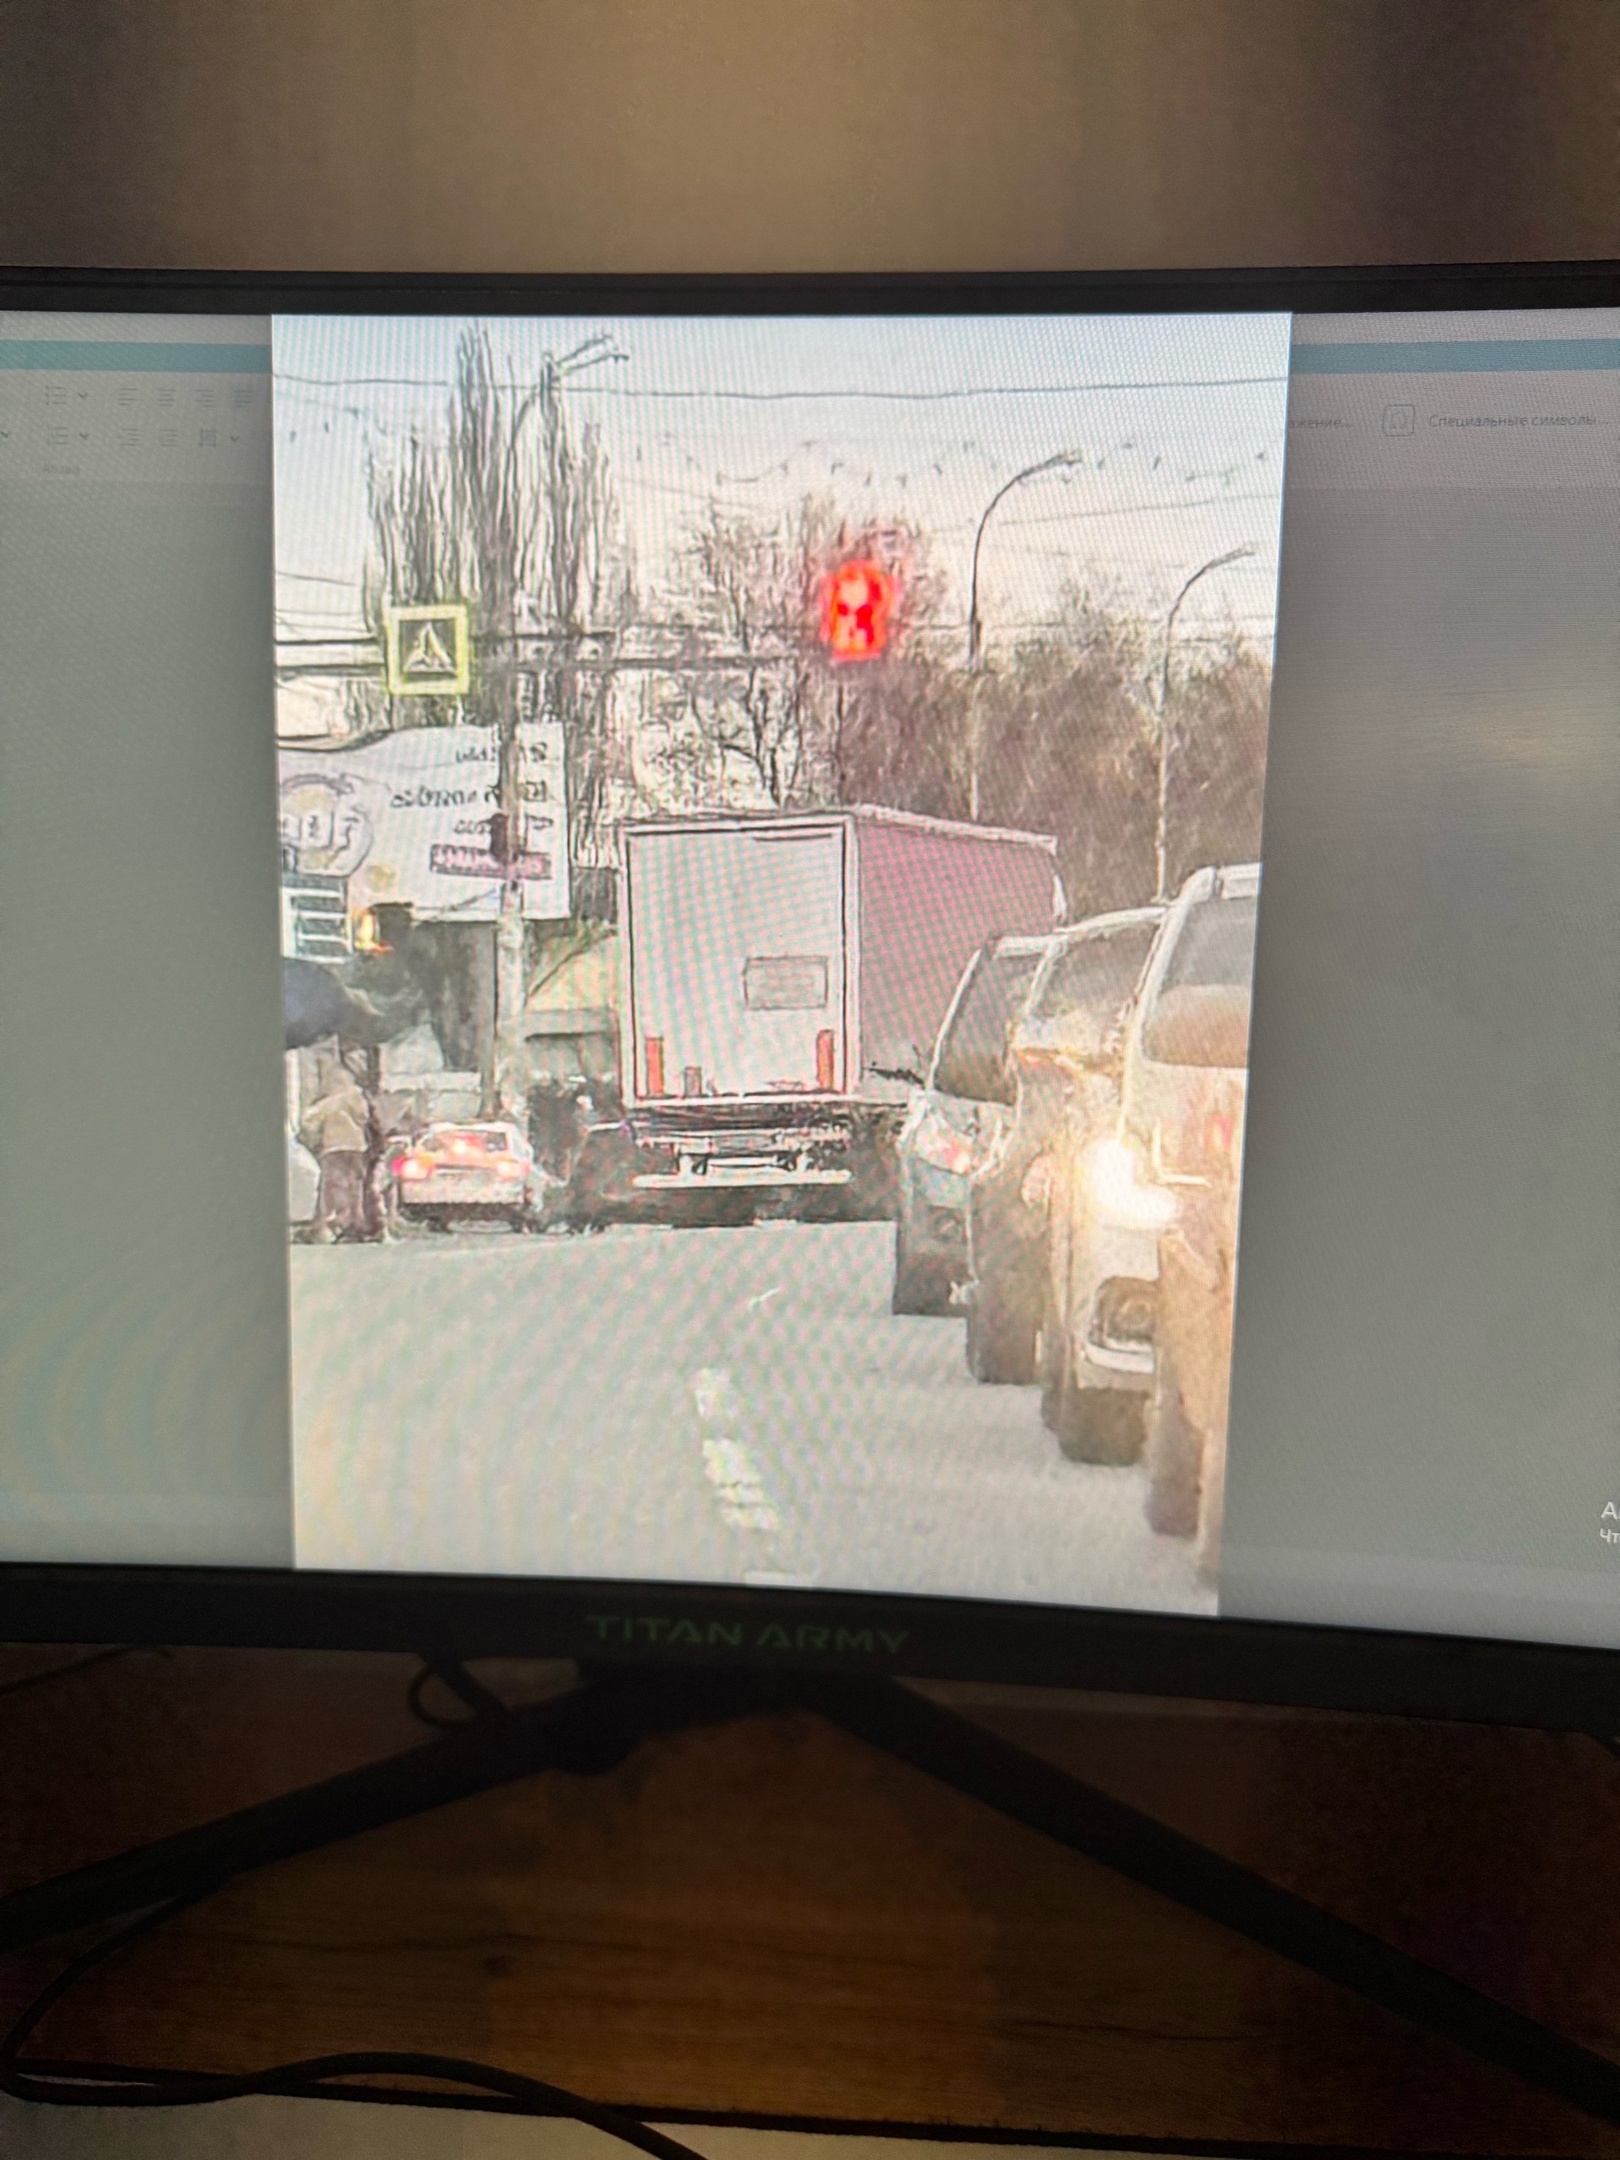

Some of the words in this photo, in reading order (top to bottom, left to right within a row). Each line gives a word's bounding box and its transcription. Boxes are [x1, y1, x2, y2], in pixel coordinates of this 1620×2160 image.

[1429, 413, 1529, 428] Специальные
[586, 1615, 742, 1646] TITAN
[756, 1623, 910, 1653] ARMY
